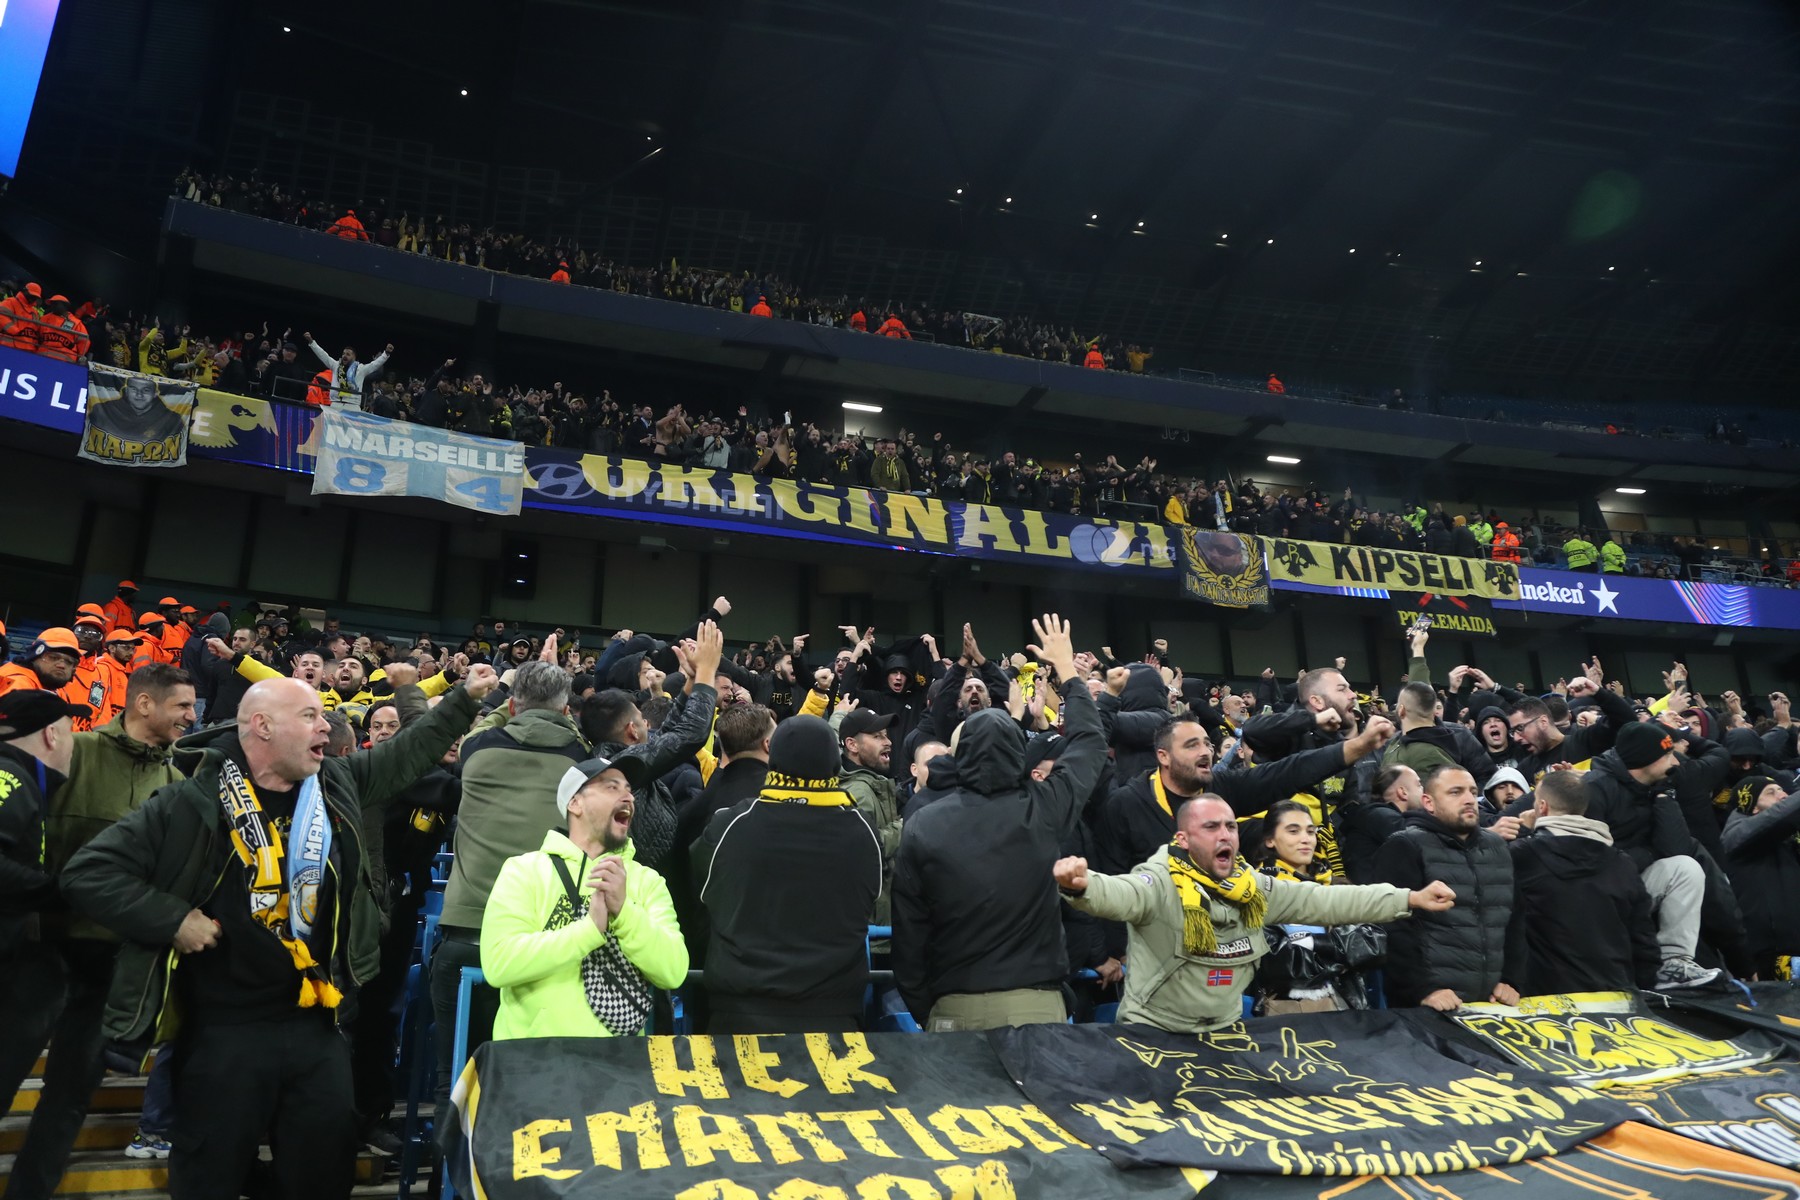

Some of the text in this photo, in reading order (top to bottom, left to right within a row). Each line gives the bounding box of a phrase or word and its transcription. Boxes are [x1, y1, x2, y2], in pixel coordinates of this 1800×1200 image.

[325, 424, 524, 474] MARSEILLE
[333, 456, 514, 512] 8 4
[1329, 545, 1475, 590] KIPSELI
[1397, 610, 1496, 634] PTLEMAIDA
